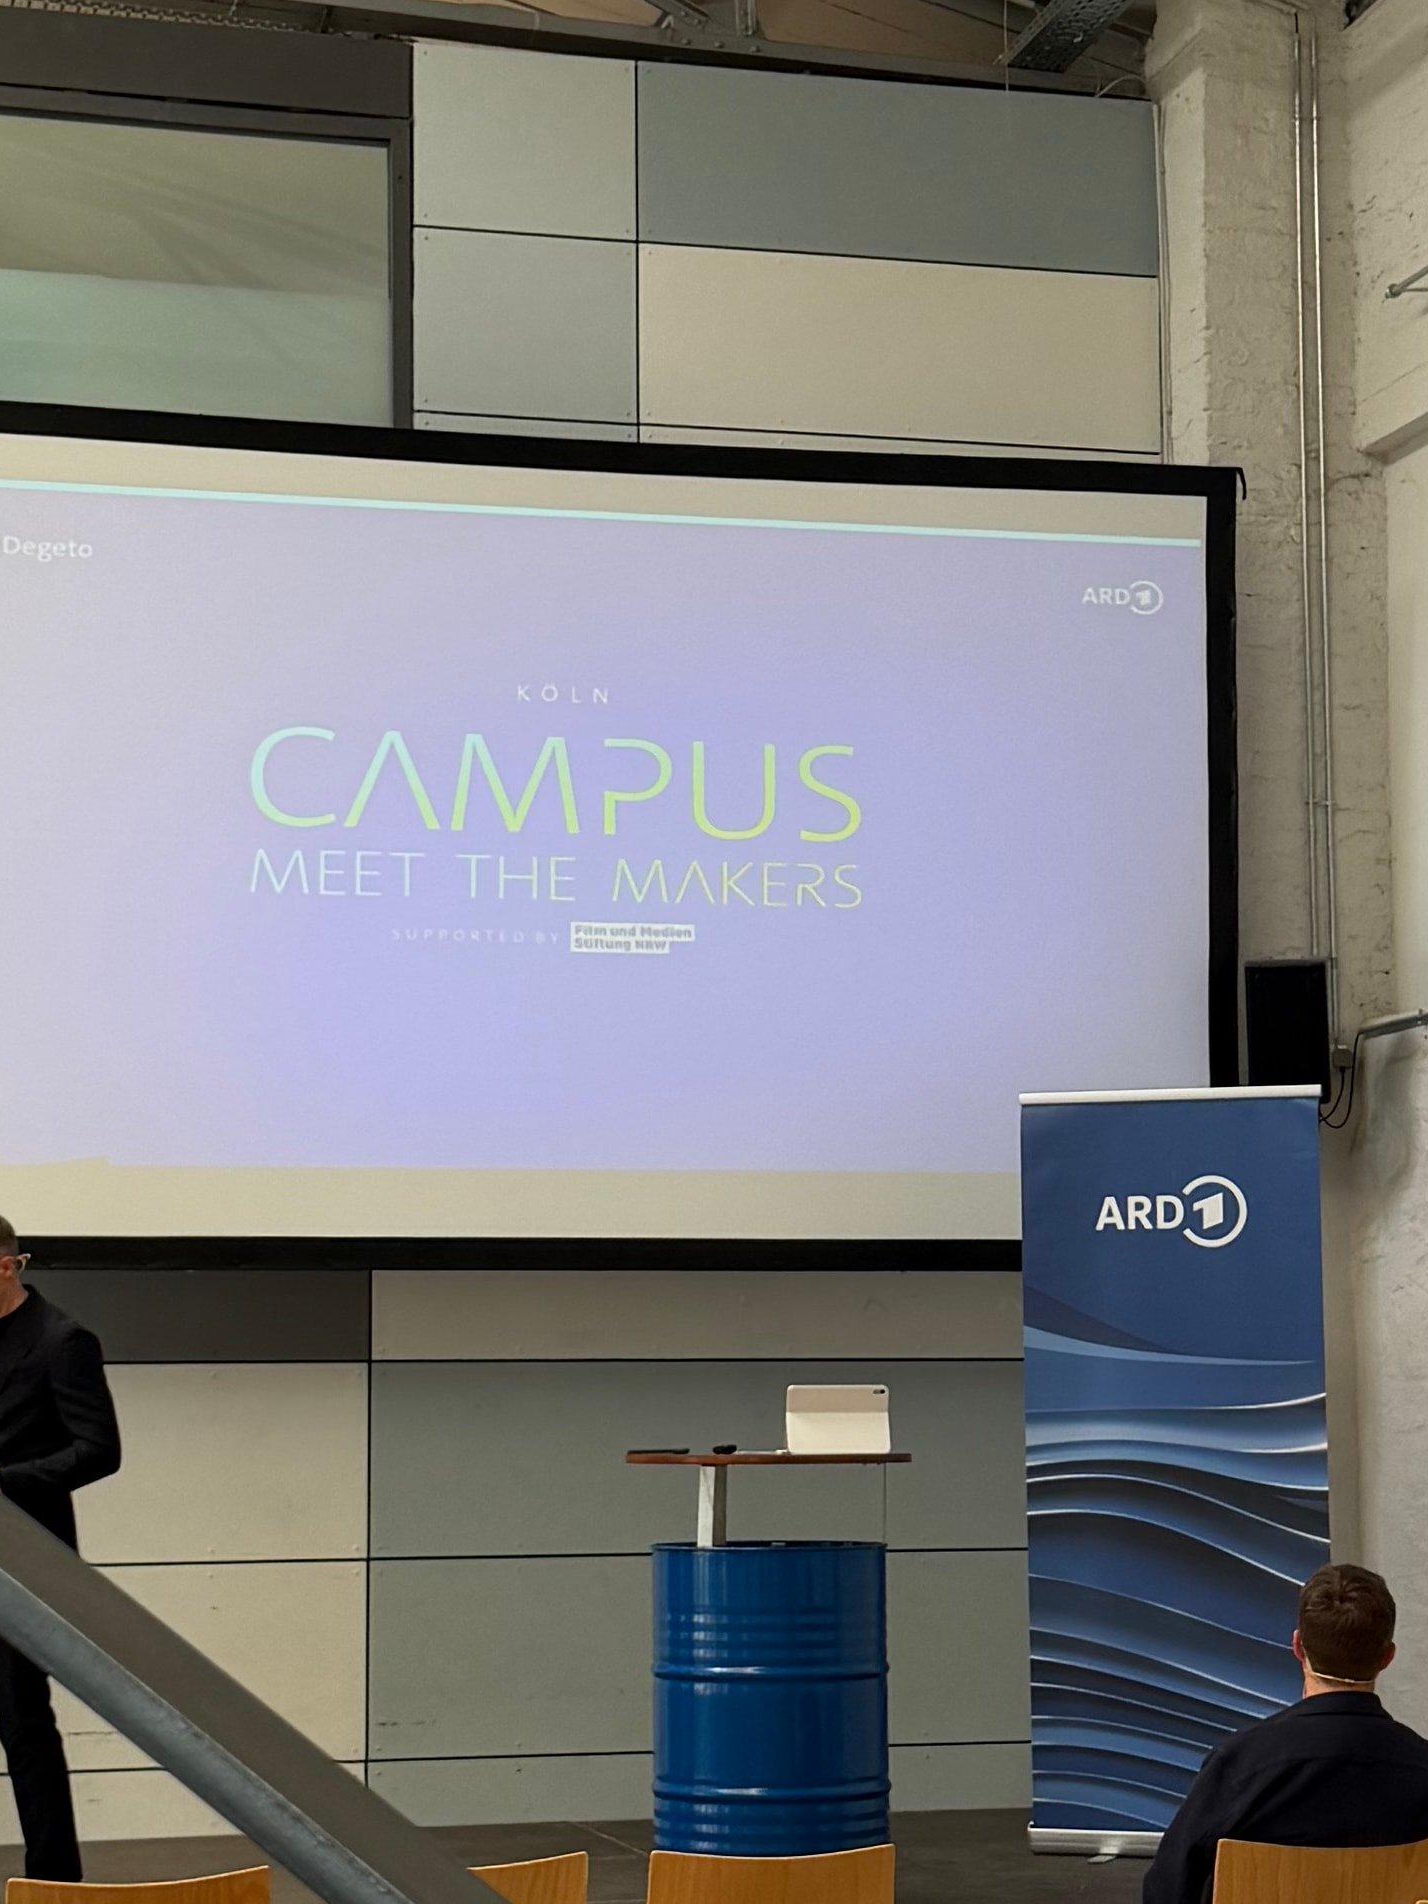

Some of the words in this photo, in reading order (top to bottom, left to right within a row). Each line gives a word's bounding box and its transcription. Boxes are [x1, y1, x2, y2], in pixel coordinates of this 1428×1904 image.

[3, 535, 93, 562] Degeto
[1082, 587, 1131, 604] ARD
[516, 683, 611, 704] KÖLN
[250, 726, 862, 842] CAMPUS
[250, 848, 426, 896] MEET
[454, 853, 576, 902] THE
[612, 859, 863, 909] MAKERS
[390, 928, 525, 943] SUPPORTED
[535, 930, 559, 945] BY
[575, 925, 608, 937] Film
[610, 927, 637, 937] und
[640, 926, 692, 939] Medien
[1095, 1195, 1185, 1231] ARD
